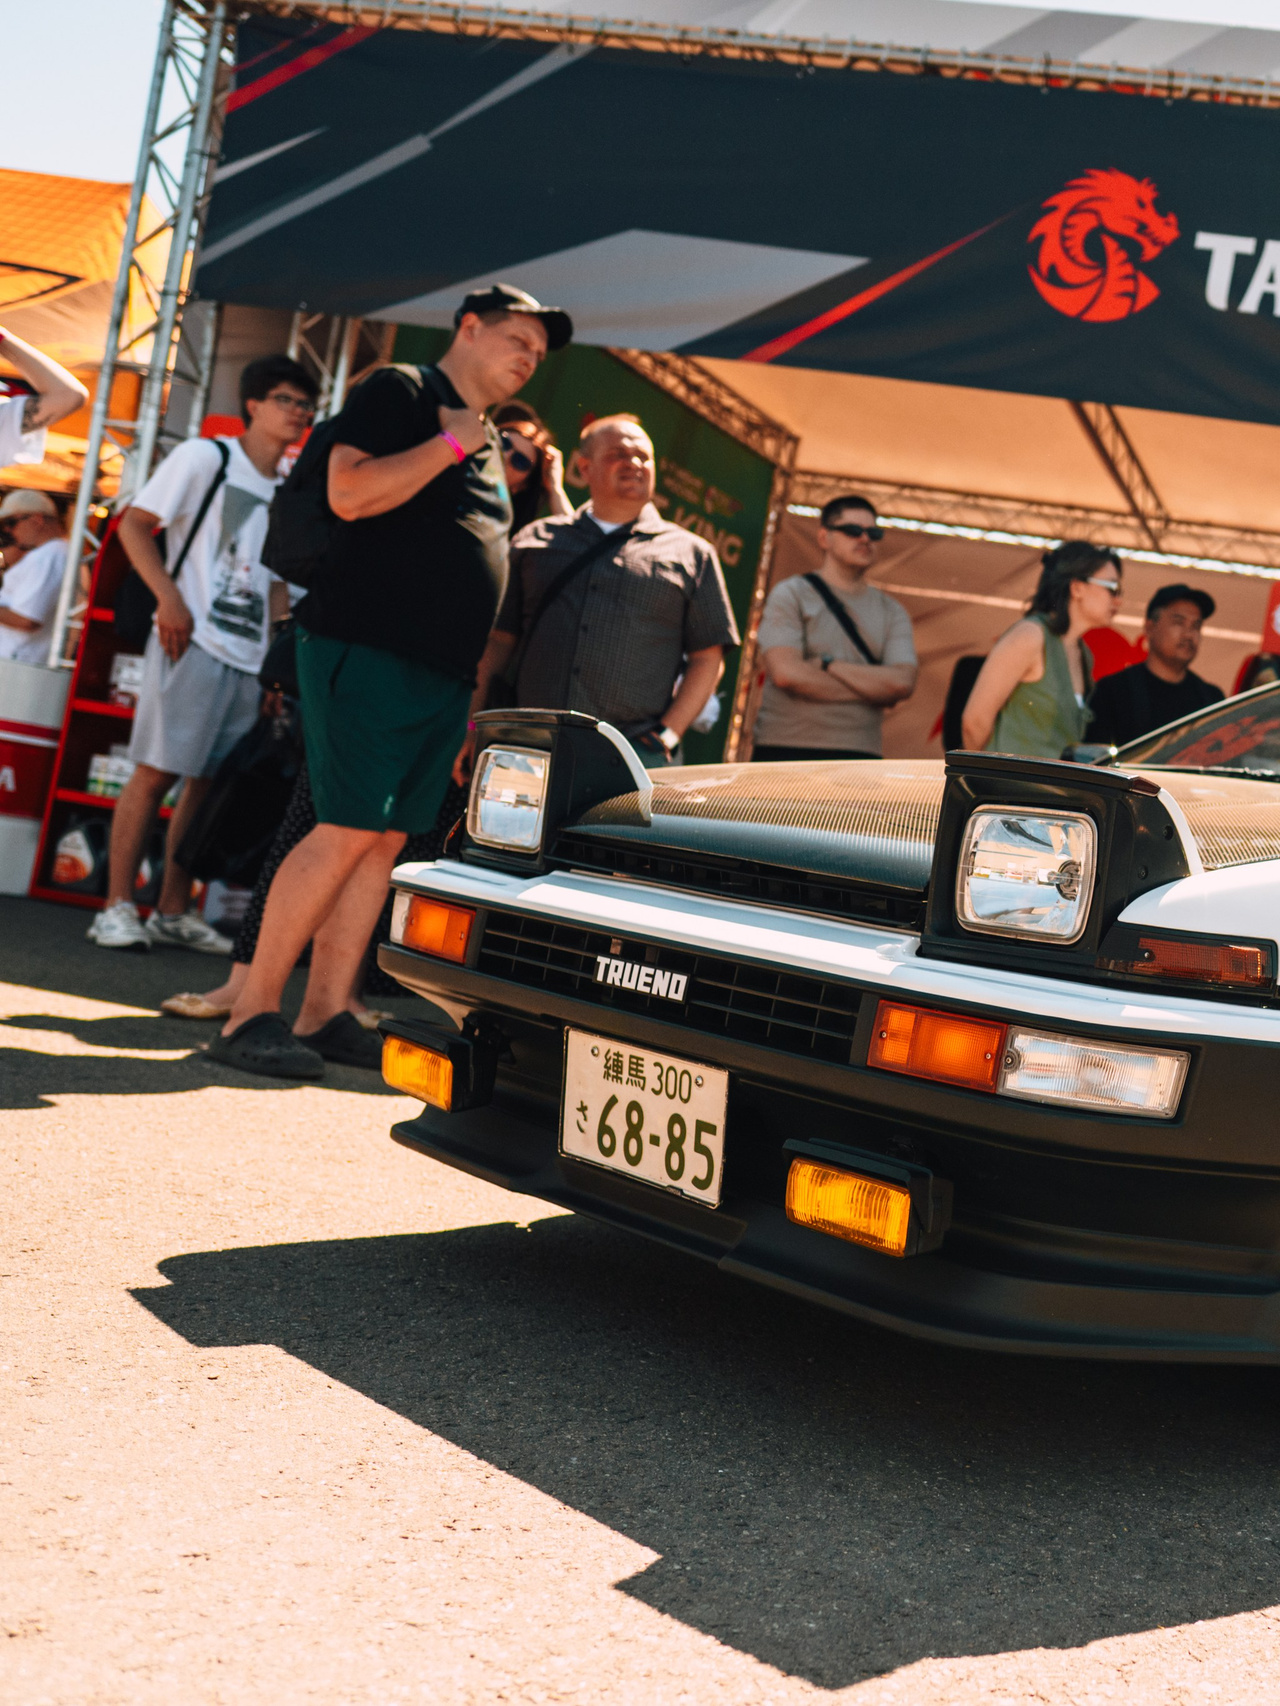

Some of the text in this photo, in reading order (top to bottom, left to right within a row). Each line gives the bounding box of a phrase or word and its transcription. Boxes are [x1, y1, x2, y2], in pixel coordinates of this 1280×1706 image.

[596, 955, 688, 1002] TRUENO
[603, 1048, 692, 1104] 練馬 300
[576, 1094, 717, 1191] さ 68-85
